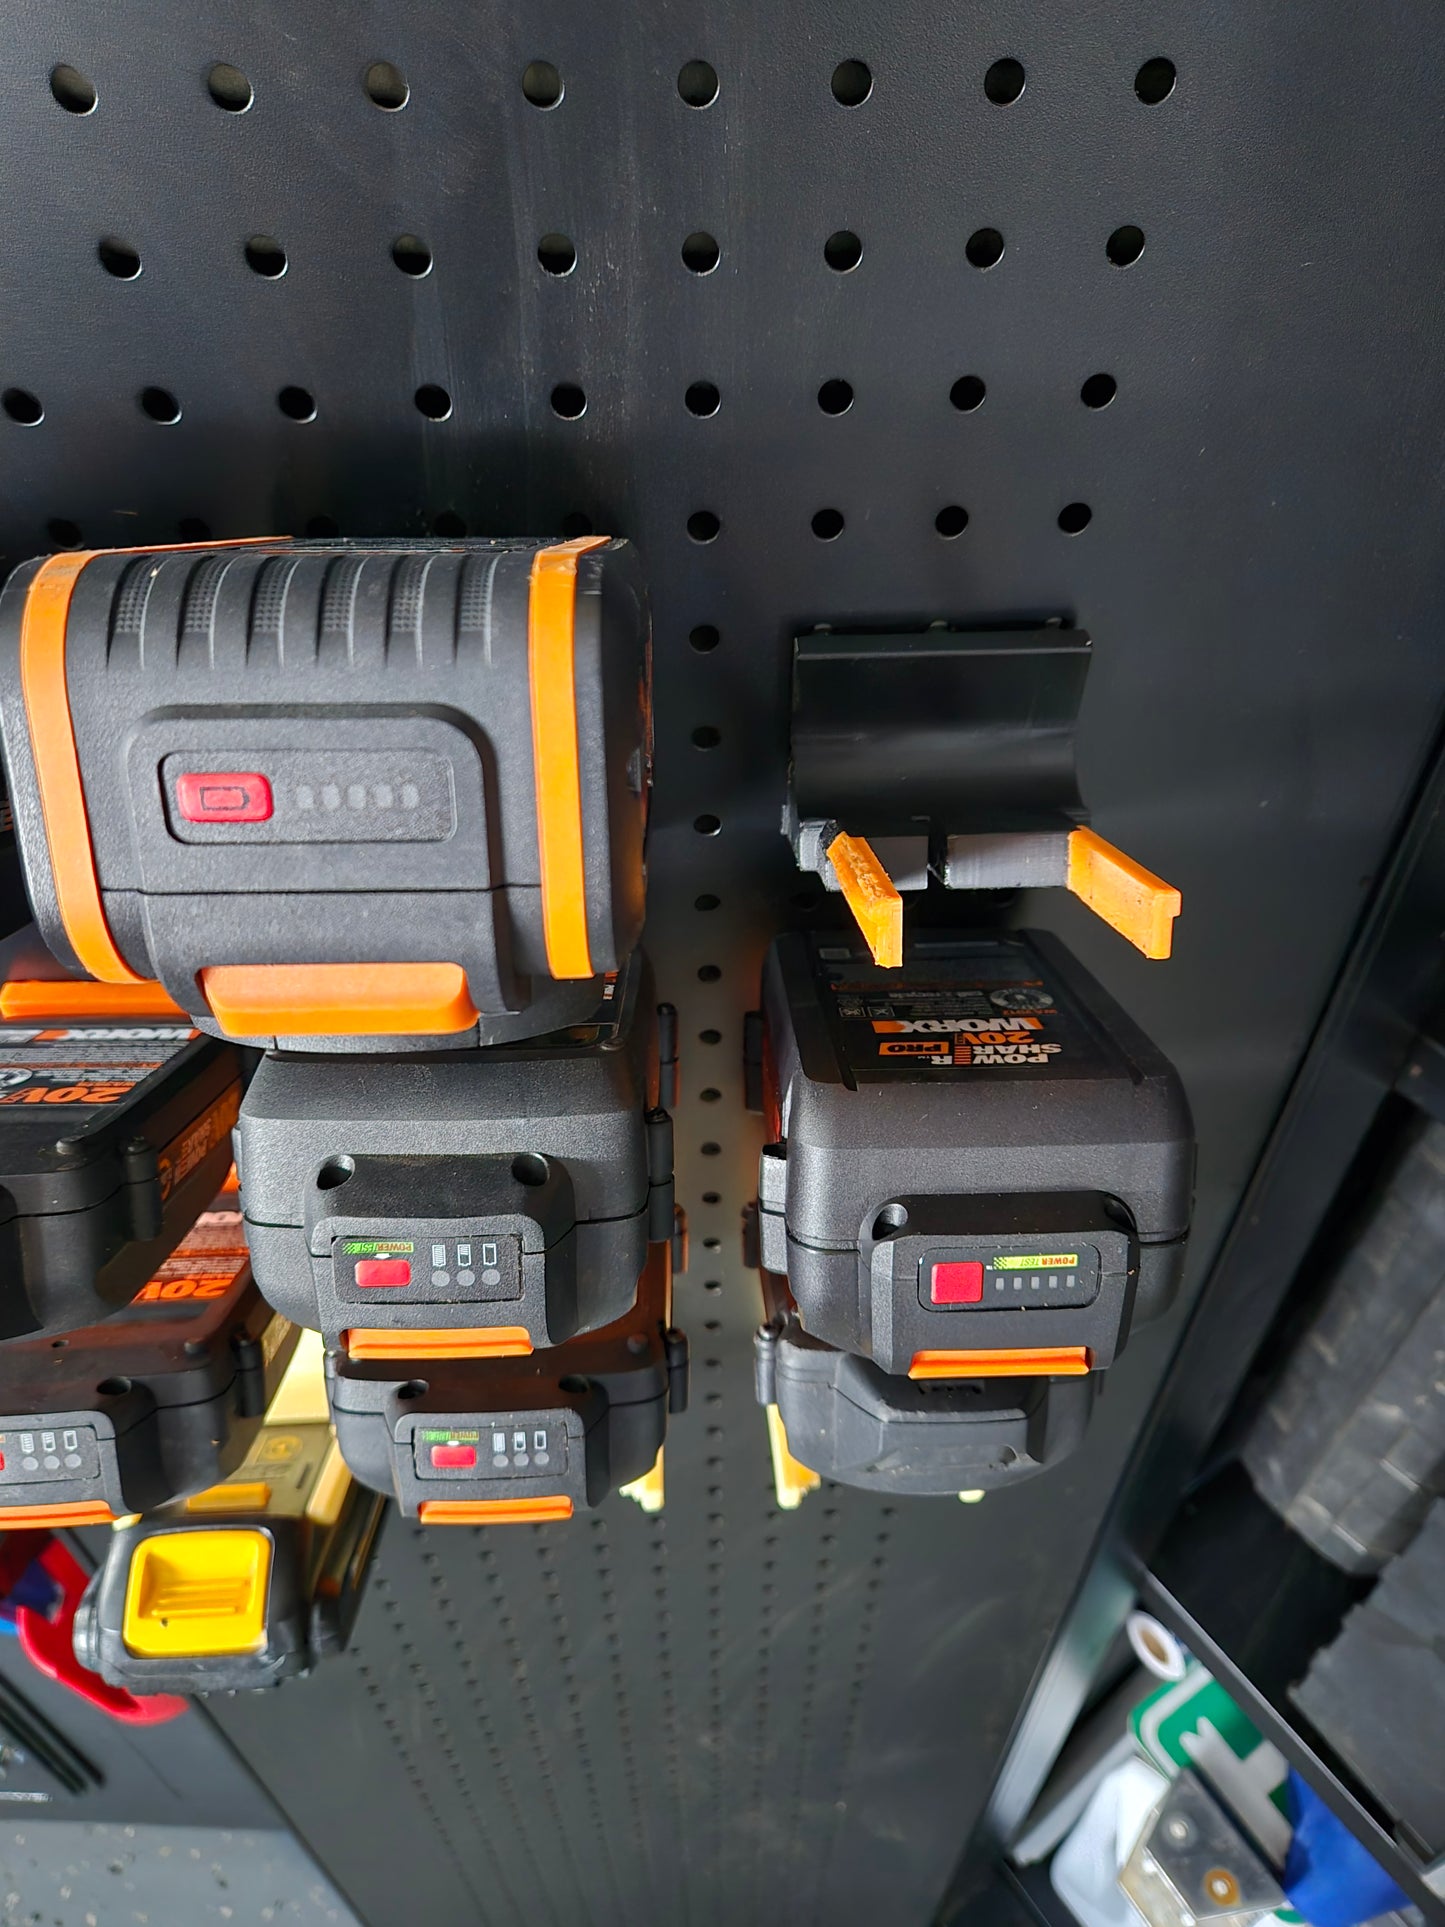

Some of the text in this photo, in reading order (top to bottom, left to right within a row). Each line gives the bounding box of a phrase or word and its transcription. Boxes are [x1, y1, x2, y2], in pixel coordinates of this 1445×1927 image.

[897, 1018, 1033, 1033] WORX
[62, 1029, 190, 1041] WORX
[963, 1031, 1034, 1044] 20V
[887, 1043, 941, 1053] PRO
[17, 1087, 134, 1103] 20V
[377, 1243, 412, 1252] POWER
[1020, 1257, 1040, 1267] TEST
[1041, 1256, 1075, 1266] POWER
